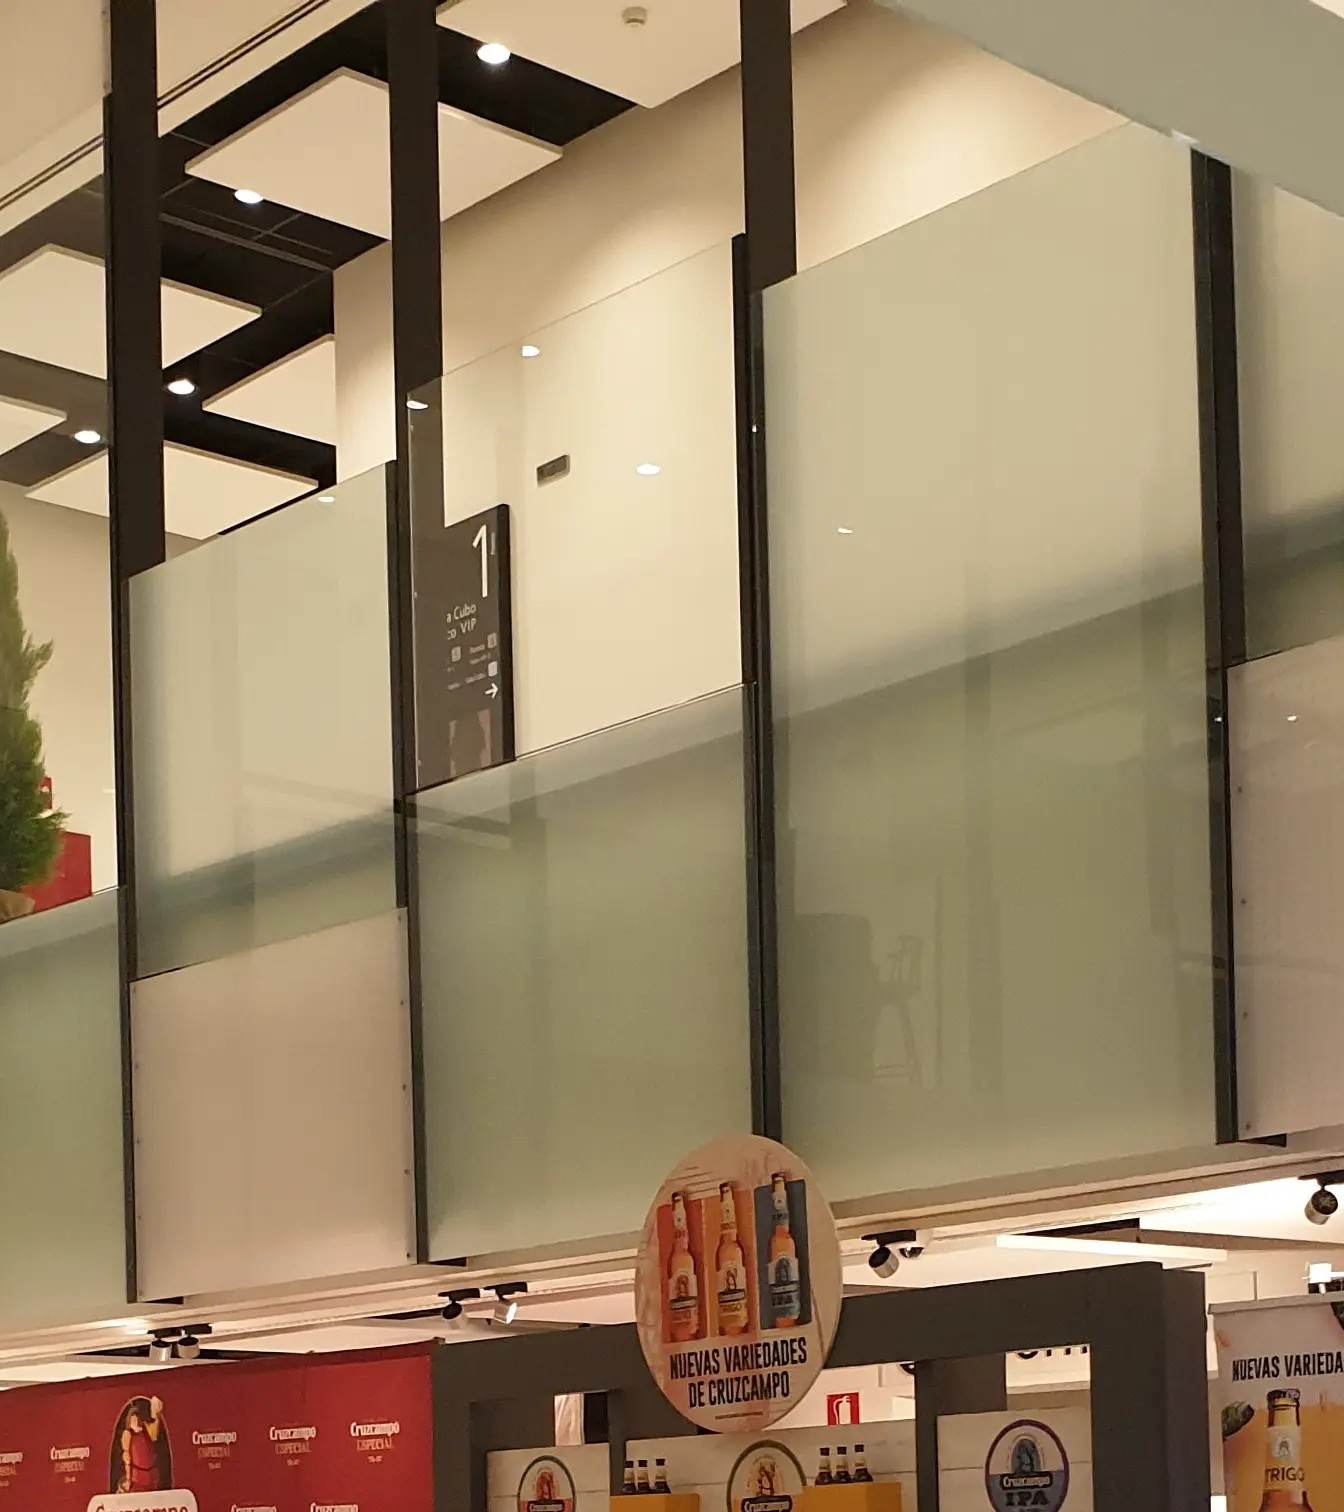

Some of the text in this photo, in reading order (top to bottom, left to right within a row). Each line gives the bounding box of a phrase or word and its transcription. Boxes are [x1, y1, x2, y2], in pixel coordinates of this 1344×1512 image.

[472, 524, 488, 598] 1
[453, 602, 477, 619] Cubo
[460, 618, 477, 635] VIP
[669, 1336, 807, 1380] NUEVAS VARIEDADES
[1232, 1354, 1281, 1382] NUEVAS
[688, 1370, 790, 1409] DE CRUZCAMPO
[1265, 1467, 1305, 1484] TRIGO
[1005, 1490, 1050, 1507] IPA
